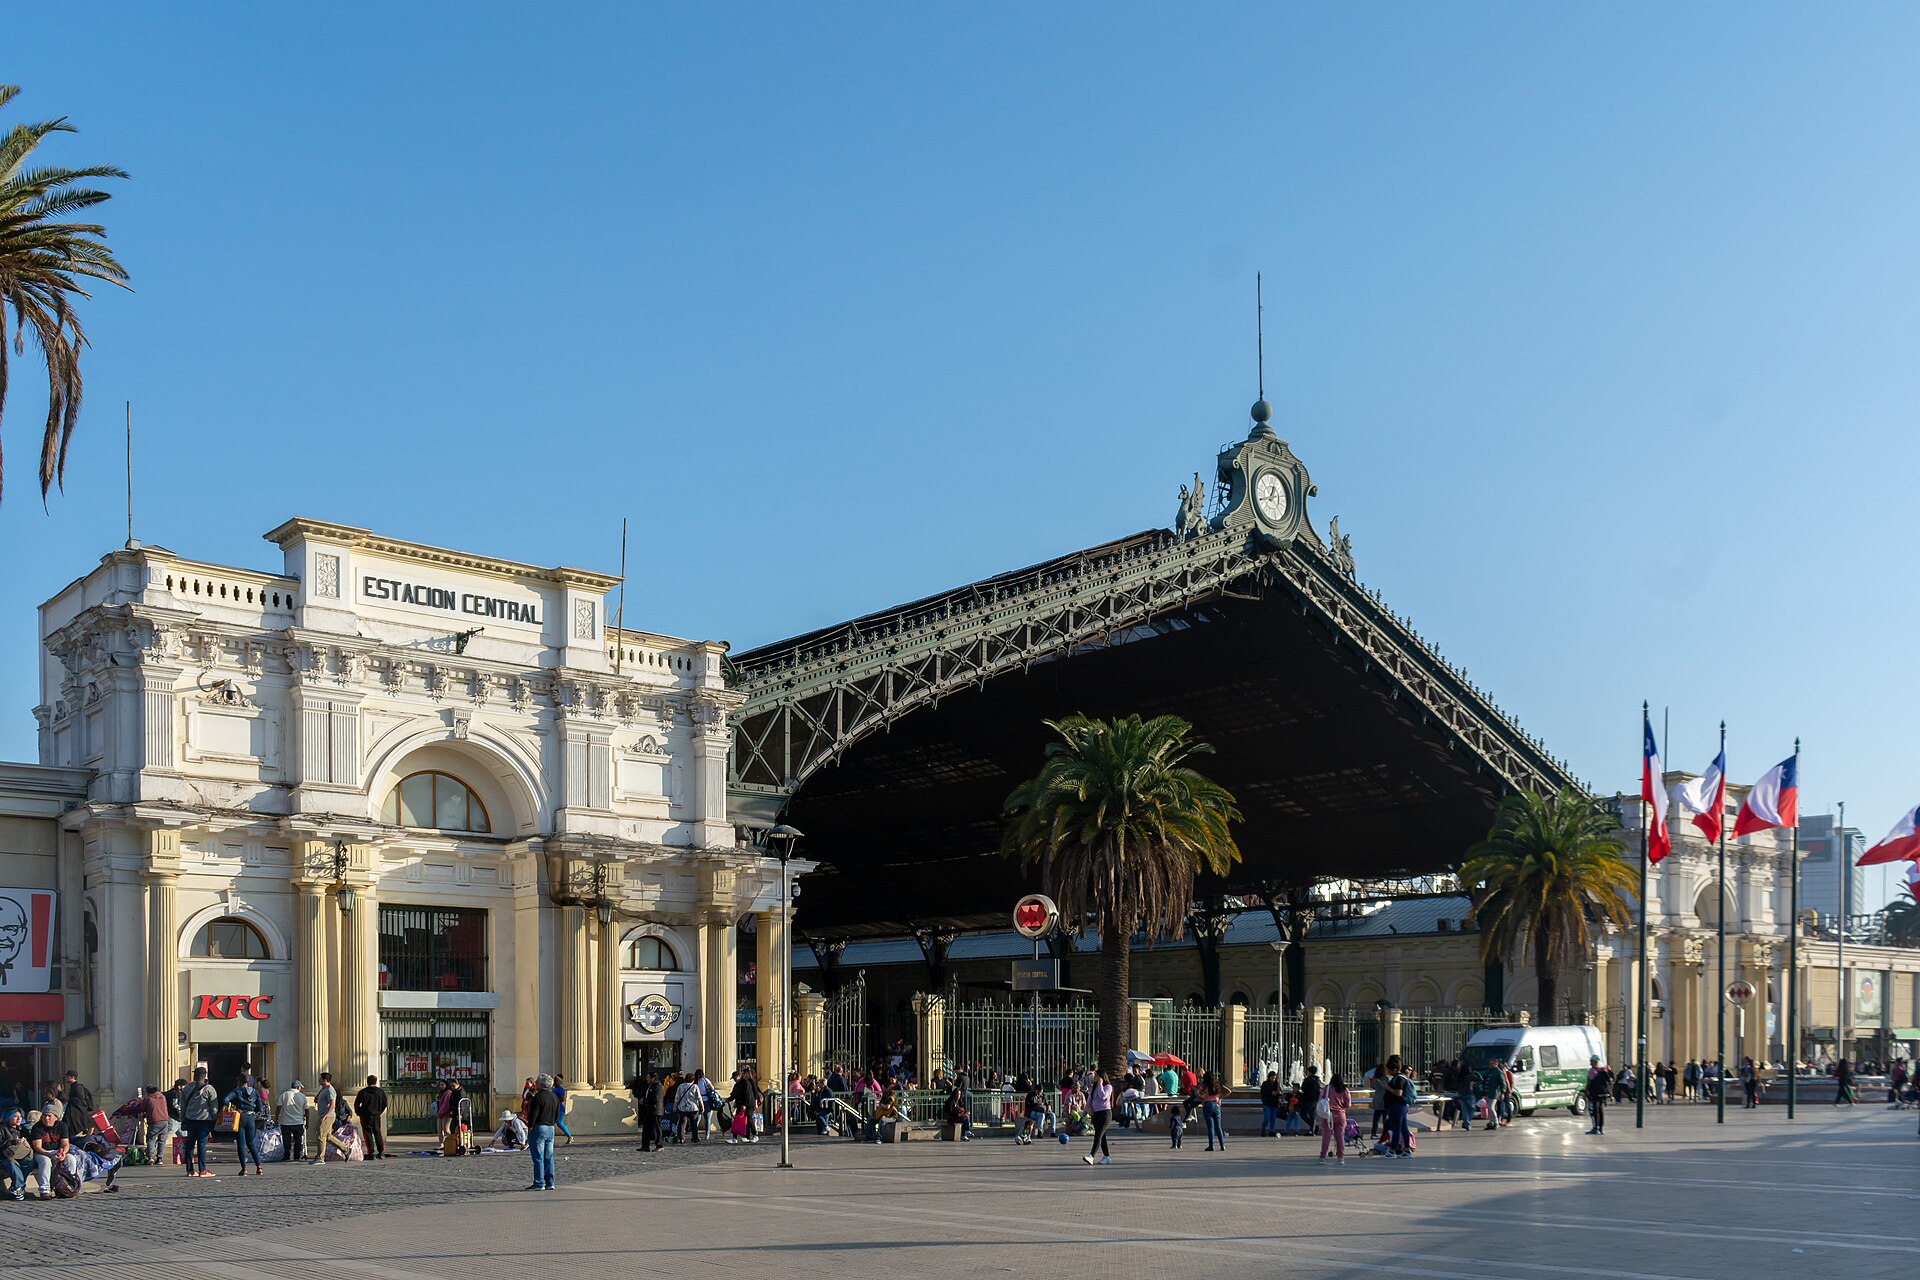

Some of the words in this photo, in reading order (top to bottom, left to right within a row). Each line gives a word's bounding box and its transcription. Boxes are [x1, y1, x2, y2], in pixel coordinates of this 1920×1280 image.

[363, 576, 455, 610] ESTACION
[461, 593, 543, 625] CENTRAL
[195, 994, 273, 1019] KFC
